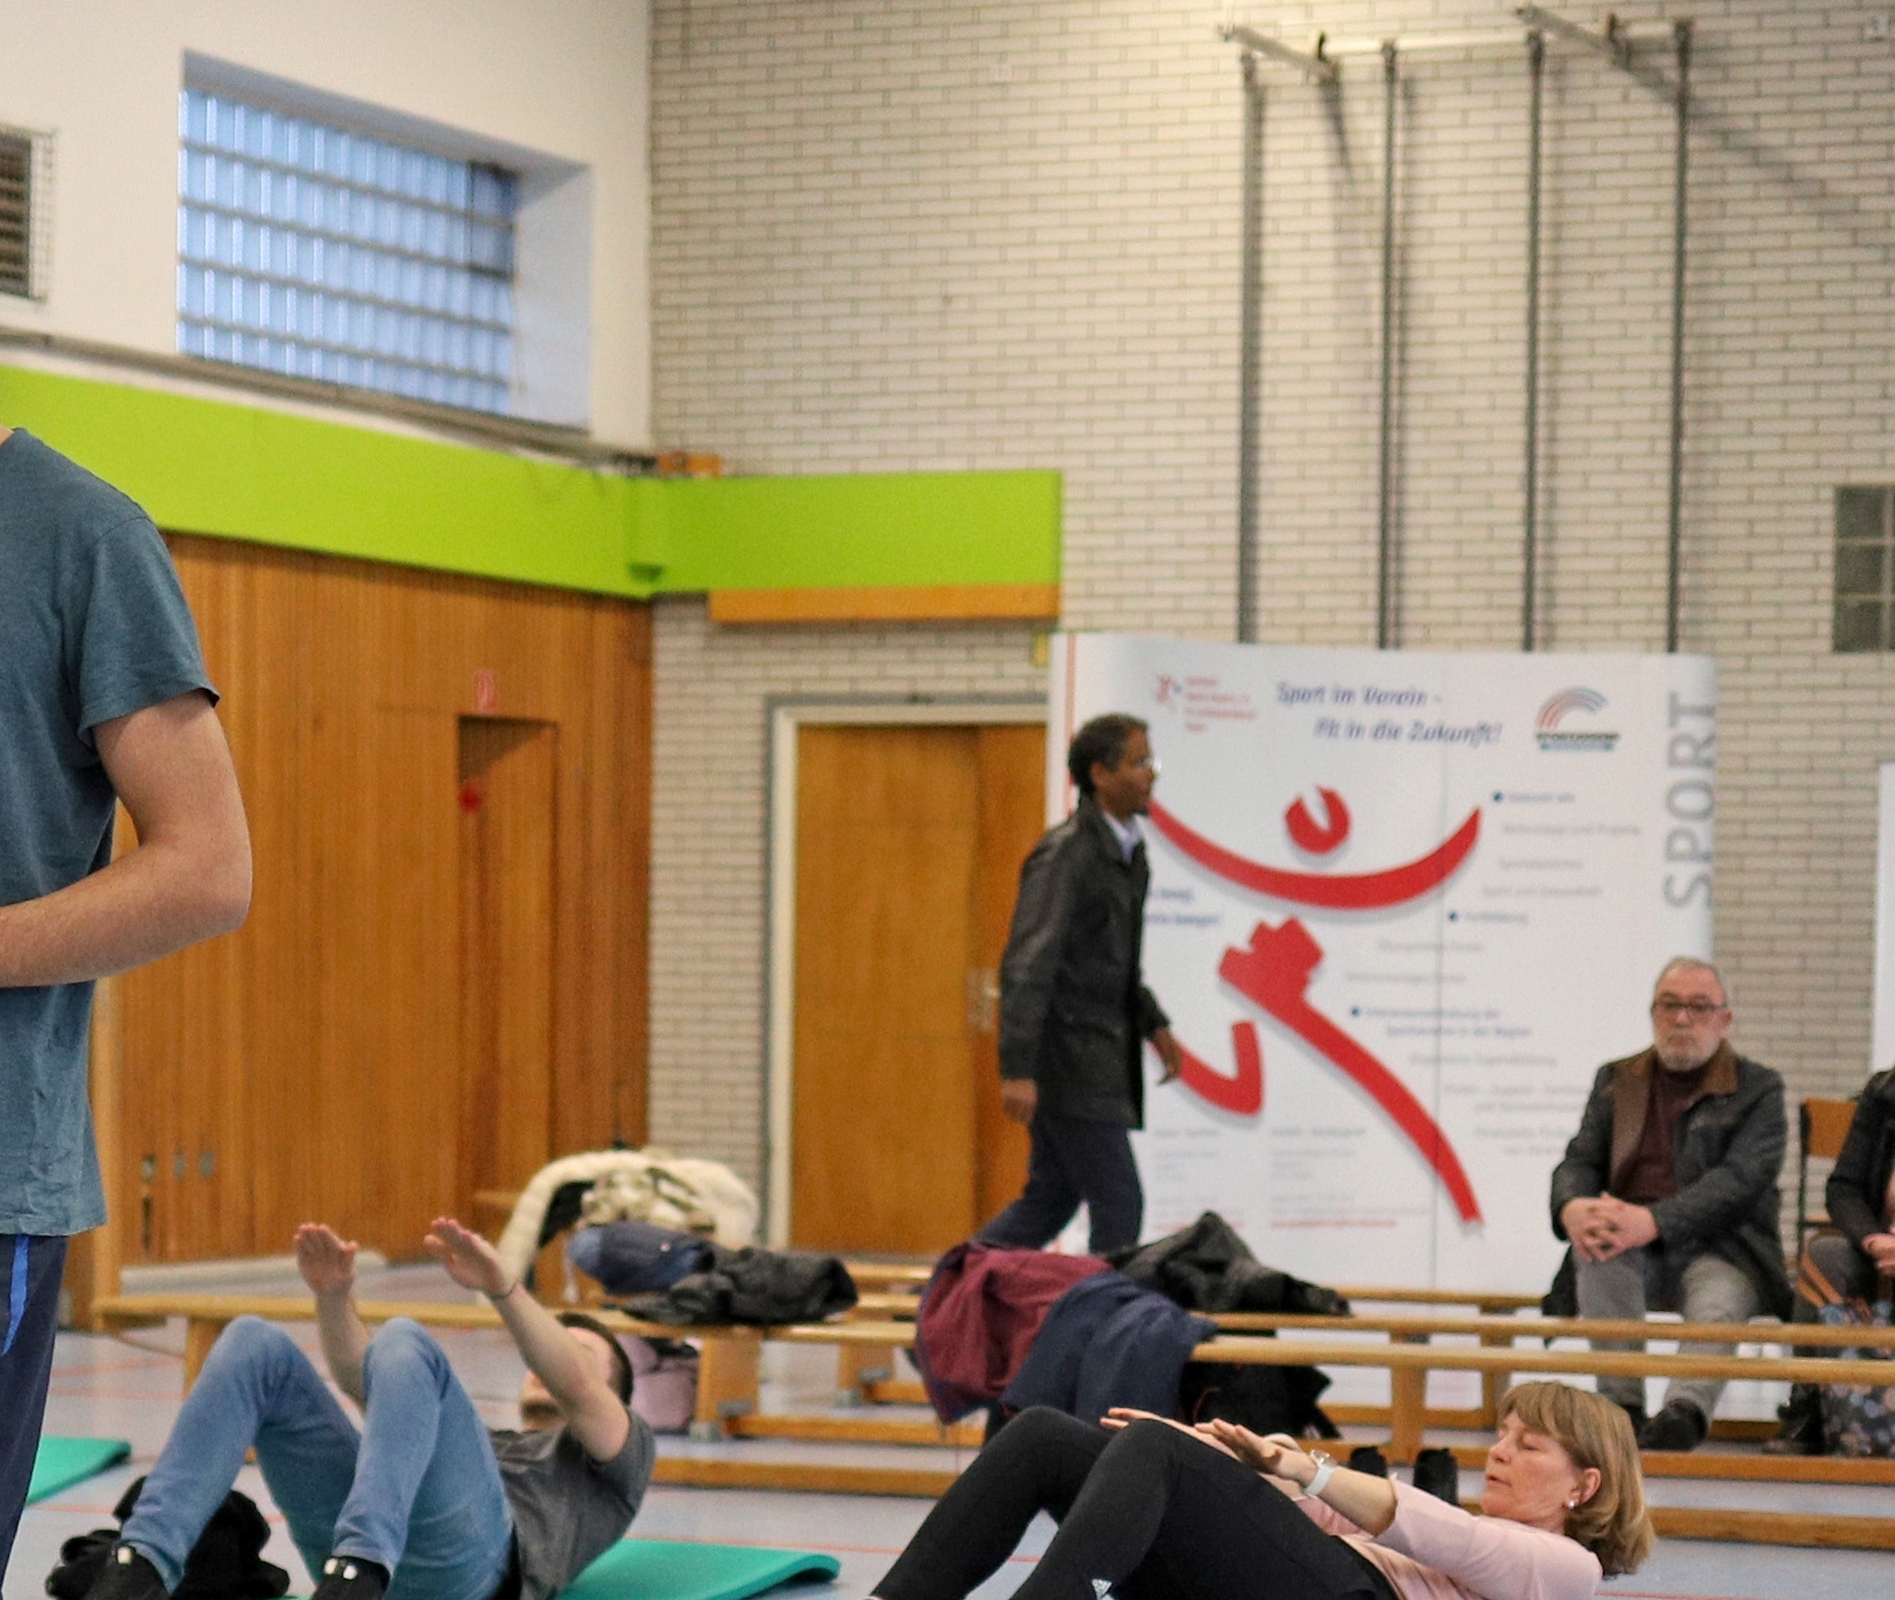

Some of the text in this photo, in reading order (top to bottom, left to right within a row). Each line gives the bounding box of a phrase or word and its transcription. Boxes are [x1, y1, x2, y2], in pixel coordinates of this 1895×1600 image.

[1276, 680, 1326, 709] Sport
[1332, 682, 1356, 705] im
[1362, 683, 1429, 707] Verein
[1314, 716, 1504, 749] Fit in die Zukunft!
[1663, 690, 1716, 908] SPORT
